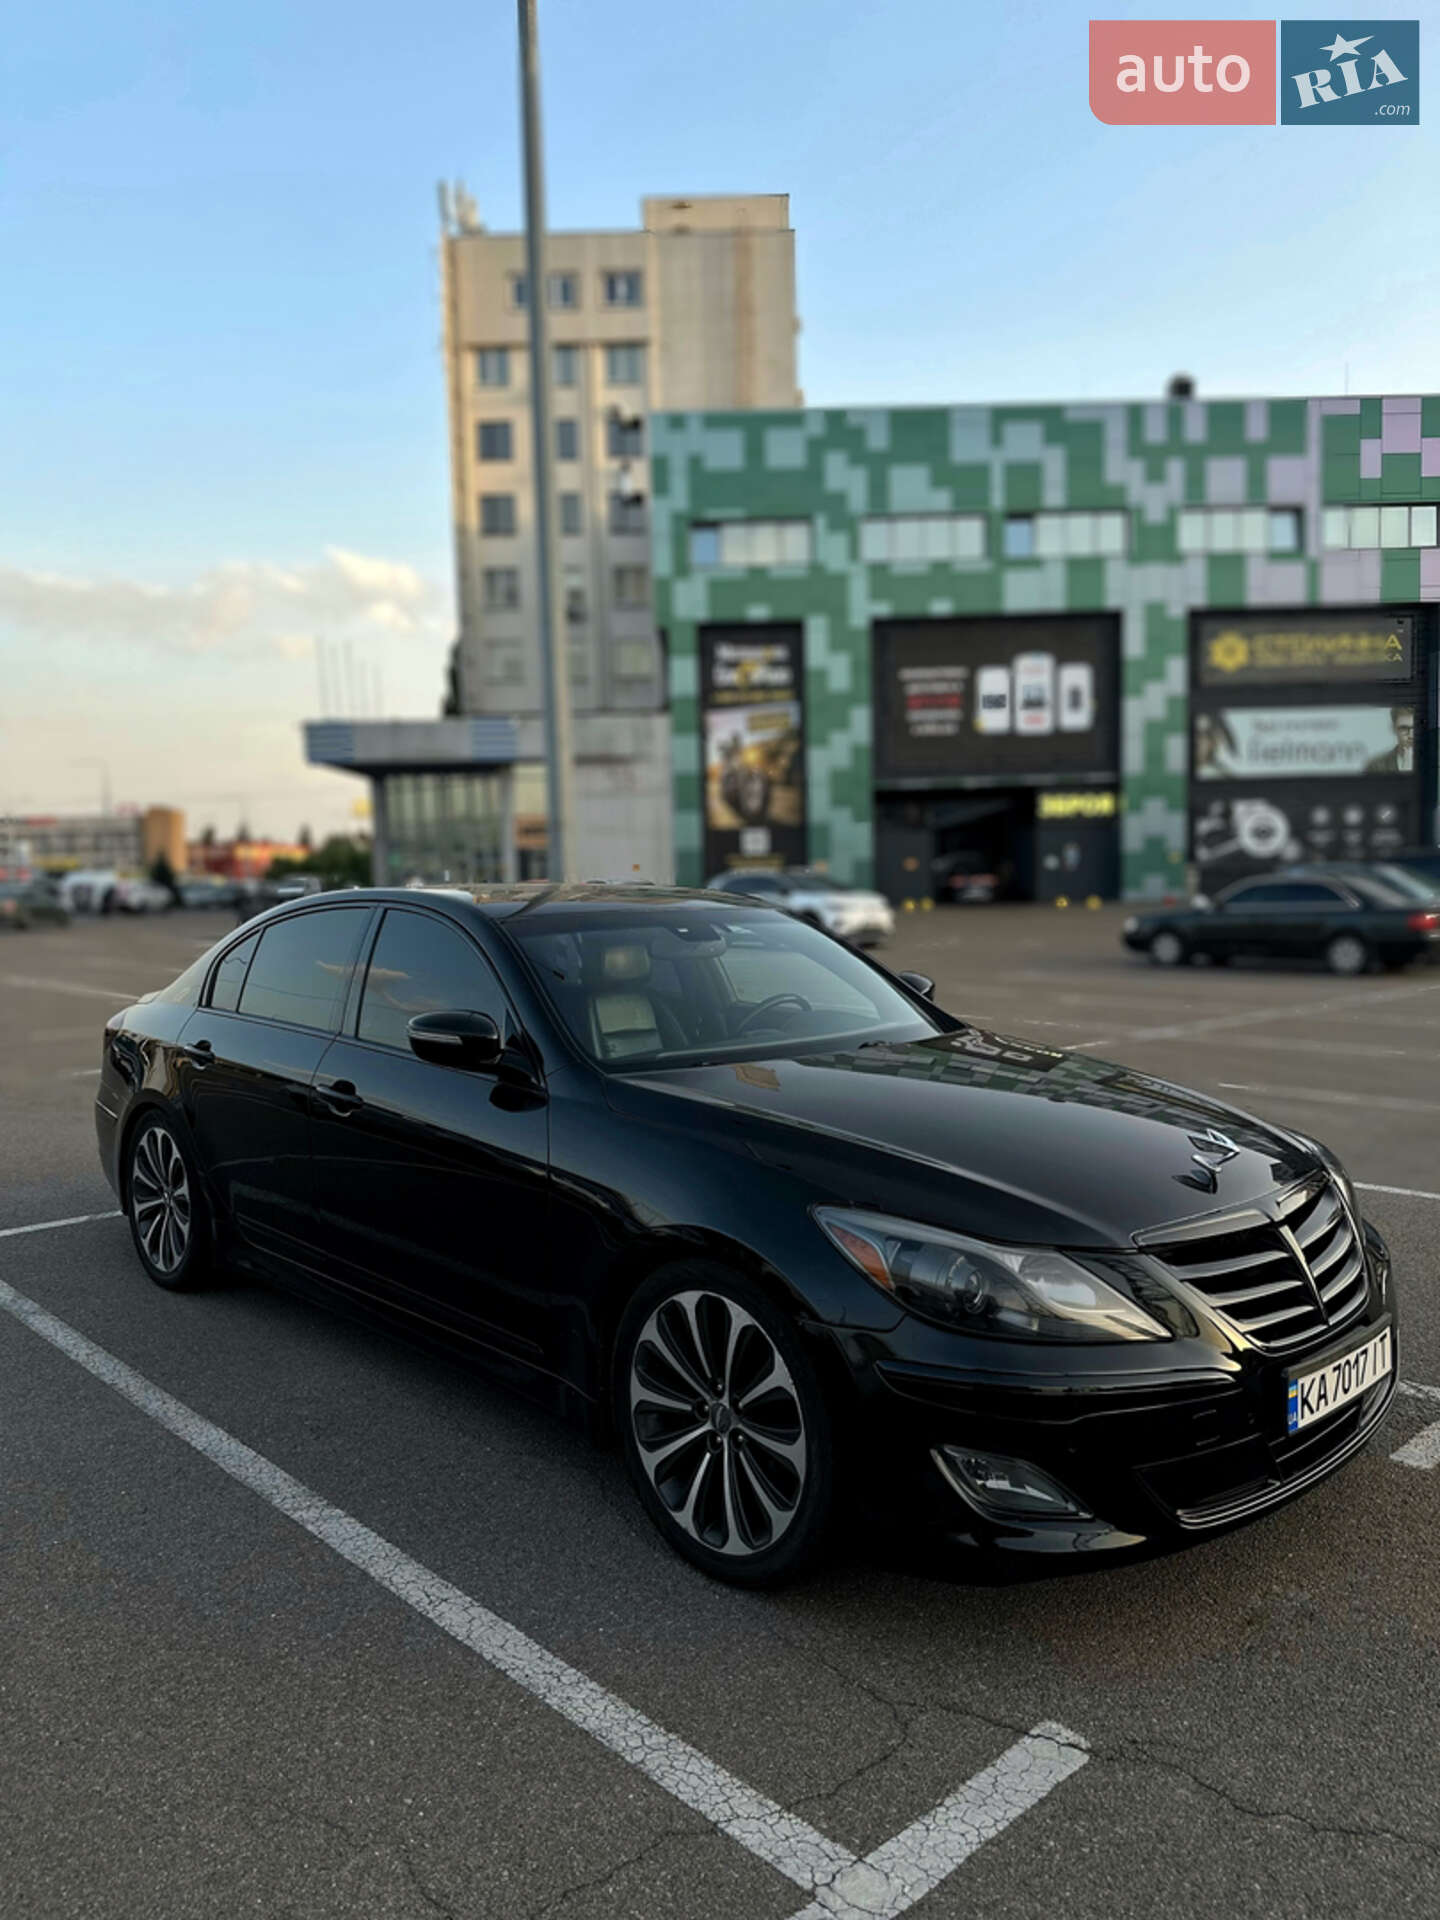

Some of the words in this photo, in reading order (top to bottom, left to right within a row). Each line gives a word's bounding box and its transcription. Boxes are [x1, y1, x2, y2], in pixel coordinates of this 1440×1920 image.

[1300, 1373, 1328, 1420] KA
[1332, 1347, 1369, 1402] 7017
[1372, 1333, 1388, 1376] IT
